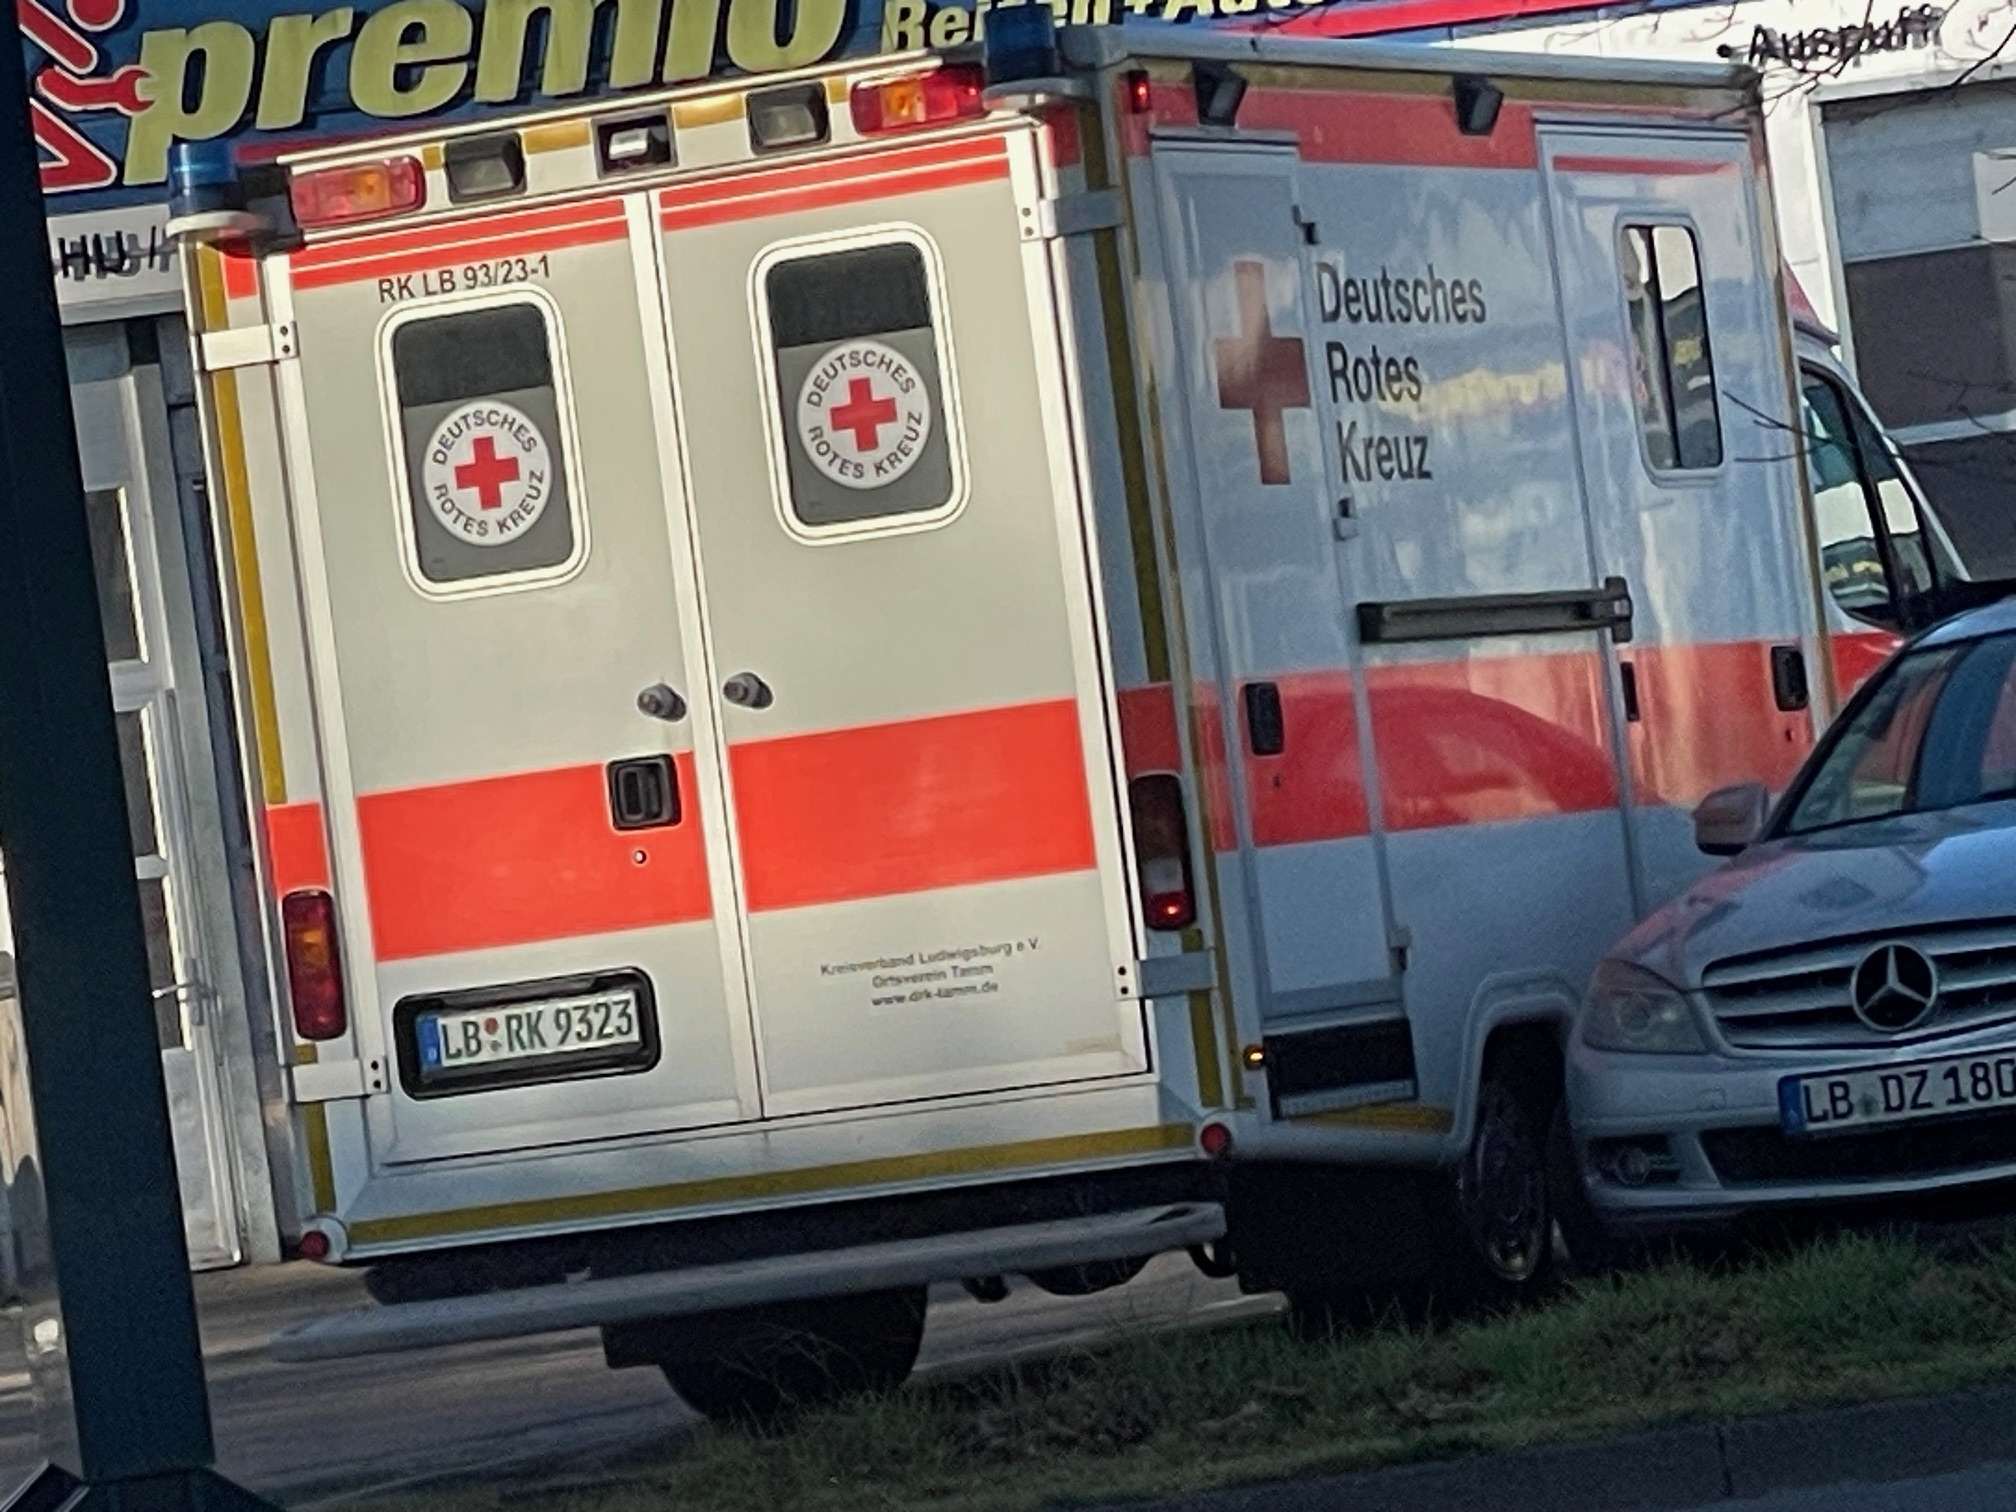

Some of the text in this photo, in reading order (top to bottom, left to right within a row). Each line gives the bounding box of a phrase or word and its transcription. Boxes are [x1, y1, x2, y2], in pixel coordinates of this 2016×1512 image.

[123, 0, 847, 186] premio
[378, 254, 551, 303] RK LB 93/23-1
[1316, 261, 1486, 324] Deutsches
[806, 349, 917, 409] DEUTSCHES
[1325, 340, 1422, 404] Rotes
[432, 409, 538, 466] DEUTSCHES
[808, 410, 923, 480] ROTES KREUZ
[1336, 419, 1433, 484] Kreuz
[433, 468, 545, 538] ROTES KREUZ
[871, 964, 994, 989] Ortsverein Tamm
[918, 941, 1014, 966] Ludwigsburg
[441, 998, 634, 1060] LB RK 9323
[1803, 1057, 2016, 1124] LB DZ 180
